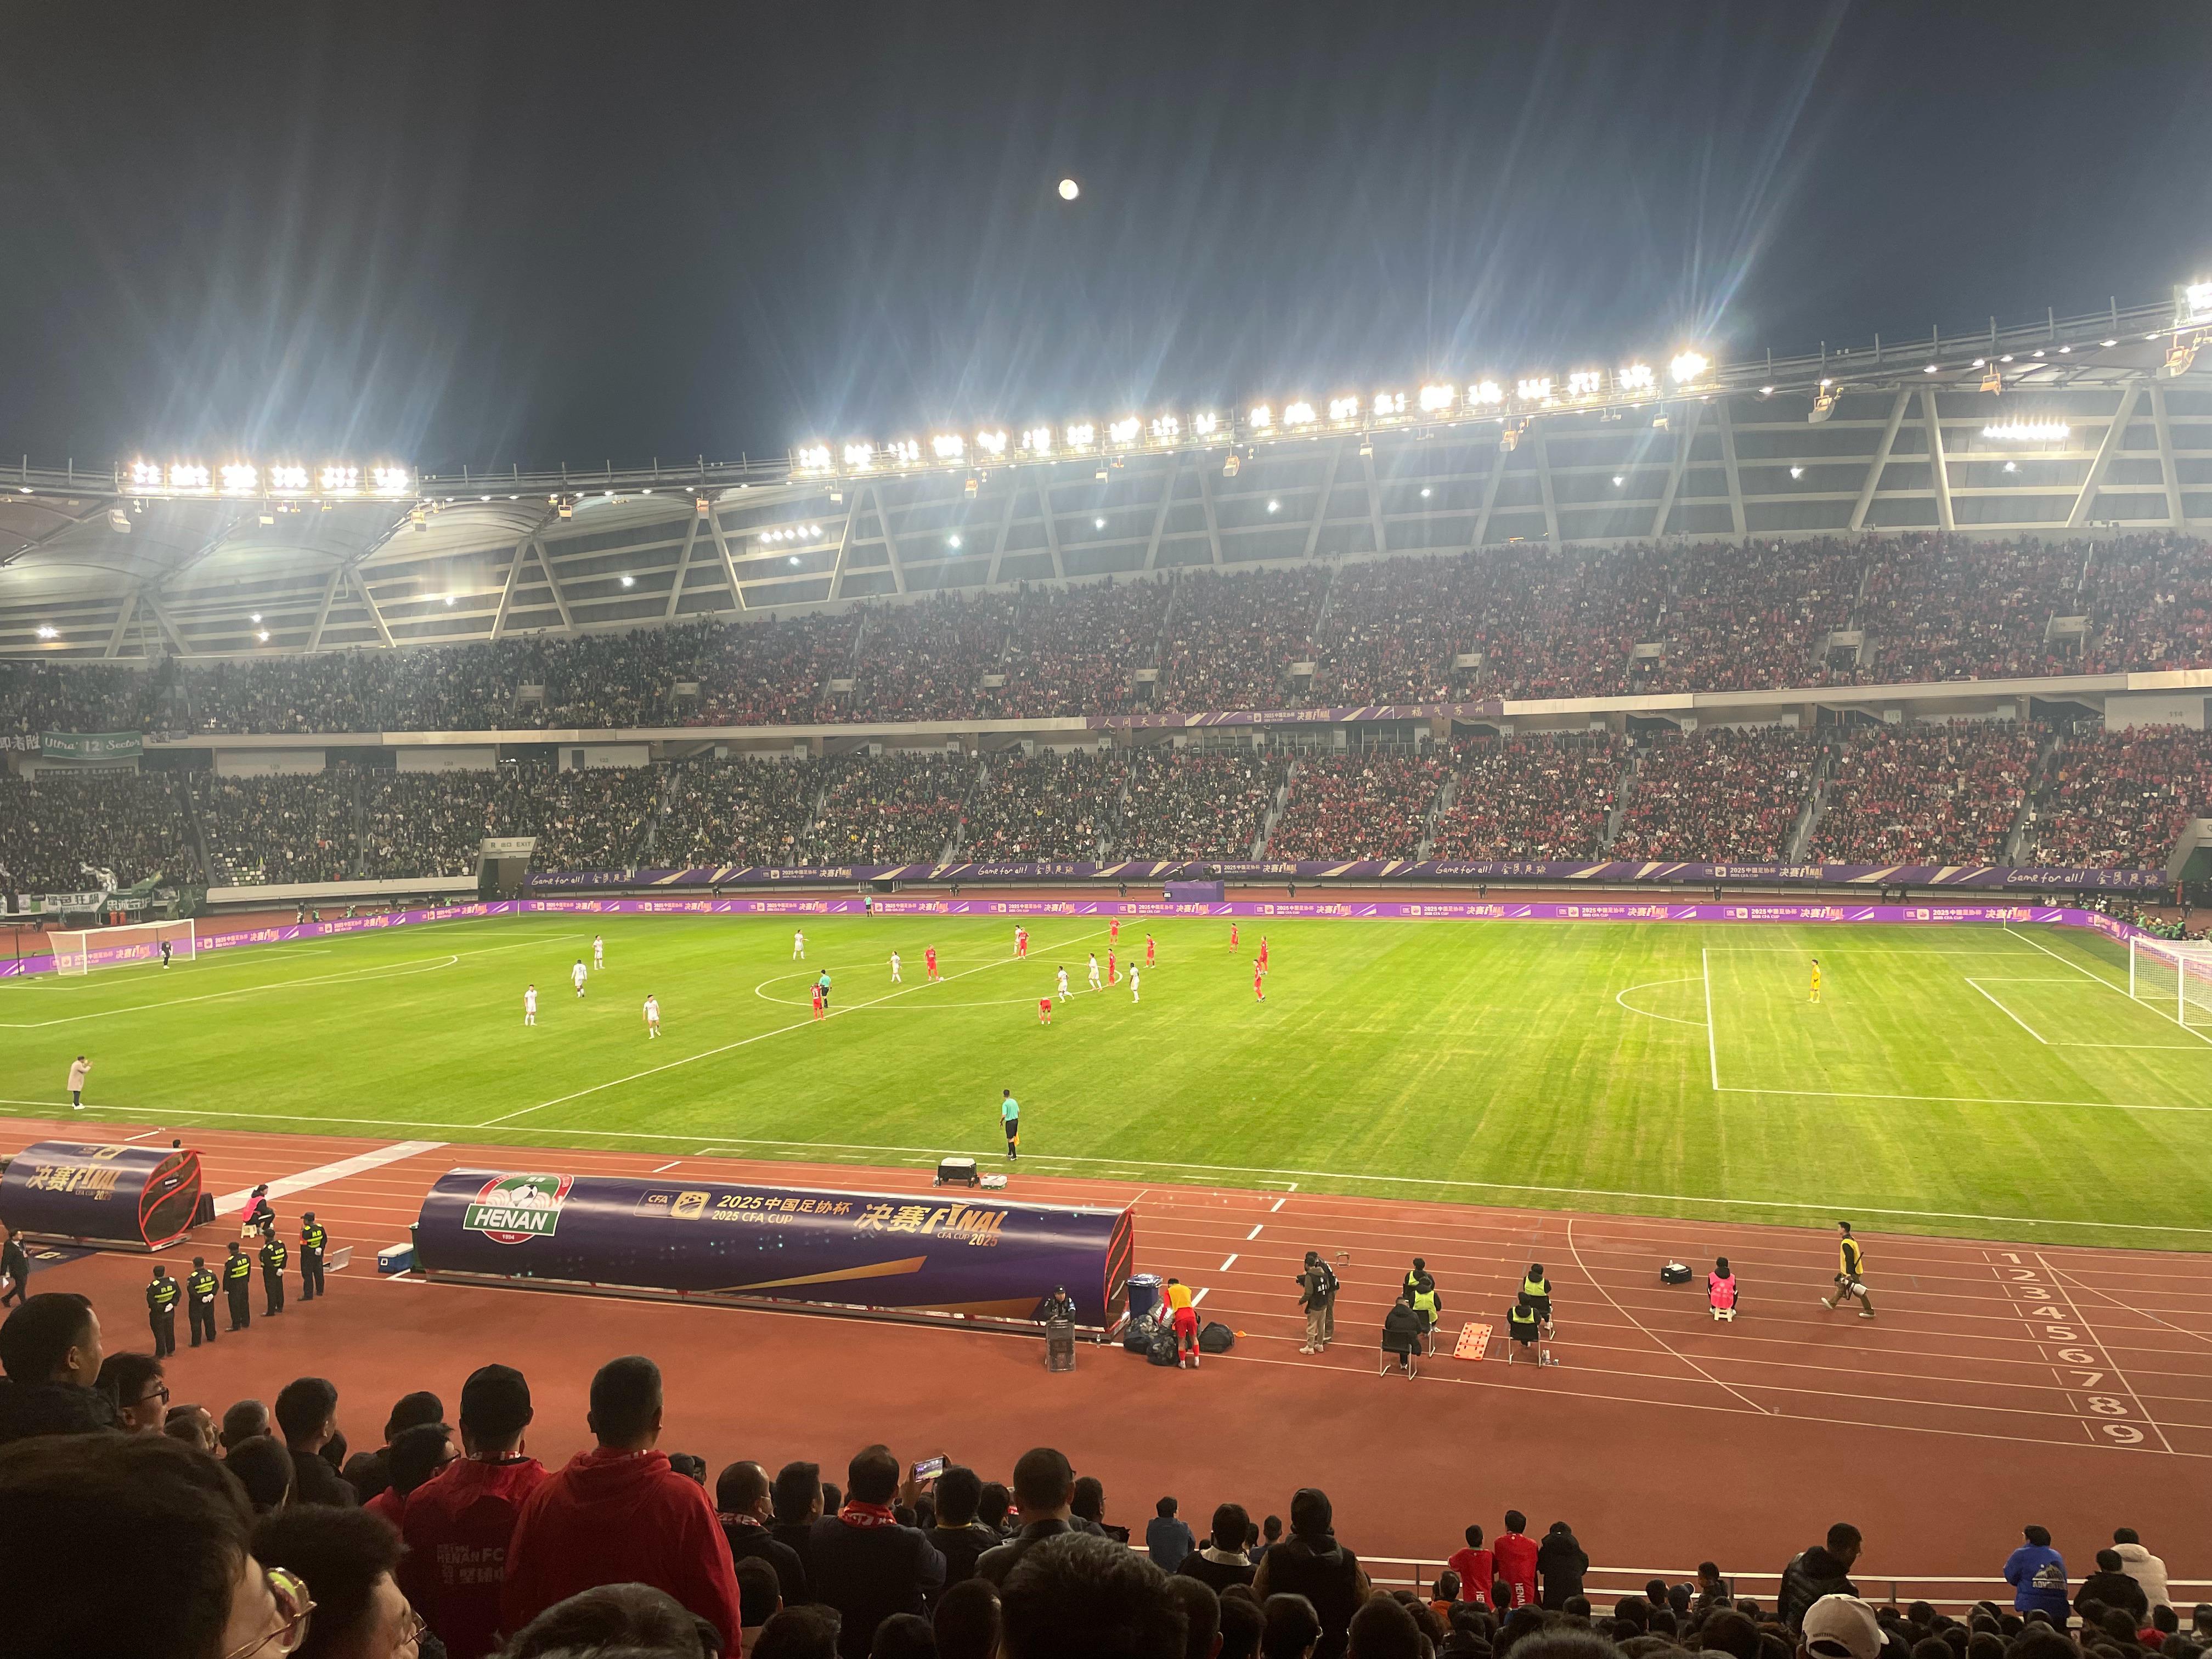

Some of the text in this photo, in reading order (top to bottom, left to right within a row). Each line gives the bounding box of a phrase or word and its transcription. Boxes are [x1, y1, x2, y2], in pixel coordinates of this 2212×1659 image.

[1412, 704, 1483, 717] 福气苏州
[1103, 716, 1167, 727] 人间天堂
[85, 741, 100, 751] 12
[106, 738, 141, 750] Sector
[978, 865, 1028, 875] Game for all!
[1436, 864, 1492, 874] Game for all!
[1779, 866, 1823, 877] 决赛FINAL
[2007, 870, 2084, 882] Game for all!
[532, 874, 584, 885] Game for all!
[25, 1163, 122, 1192] 决赛FINAL
[94, 1190, 112, 1200] 2025
[648, 1195, 668, 1204] CFA
[717, 1195, 853, 1216] 2025中国足协杯
[474, 1208, 548, 1231] HENAN
[712, 1210, 793, 1225] 2025 CFA CUP
[853, 1204, 1008, 1234] 决赛FINAL
[968, 1233, 998, 1247] 2025
[2001, 1253, 2022, 1264] 1
[2008, 1269, 2040, 1282] 2
[2020, 1286, 2051, 1300] 3
[2032, 1306, 2066, 1320] 4
[2046, 1325, 2078, 1340] 5
[2058, 1348, 2095, 1364] 6
[2069, 1370, 2103, 1387] 7
[2087, 1396, 2128, 1415] 8
[2102, 1424, 2144, 1444] 9
[483, 1548, 504, 1562] FC
